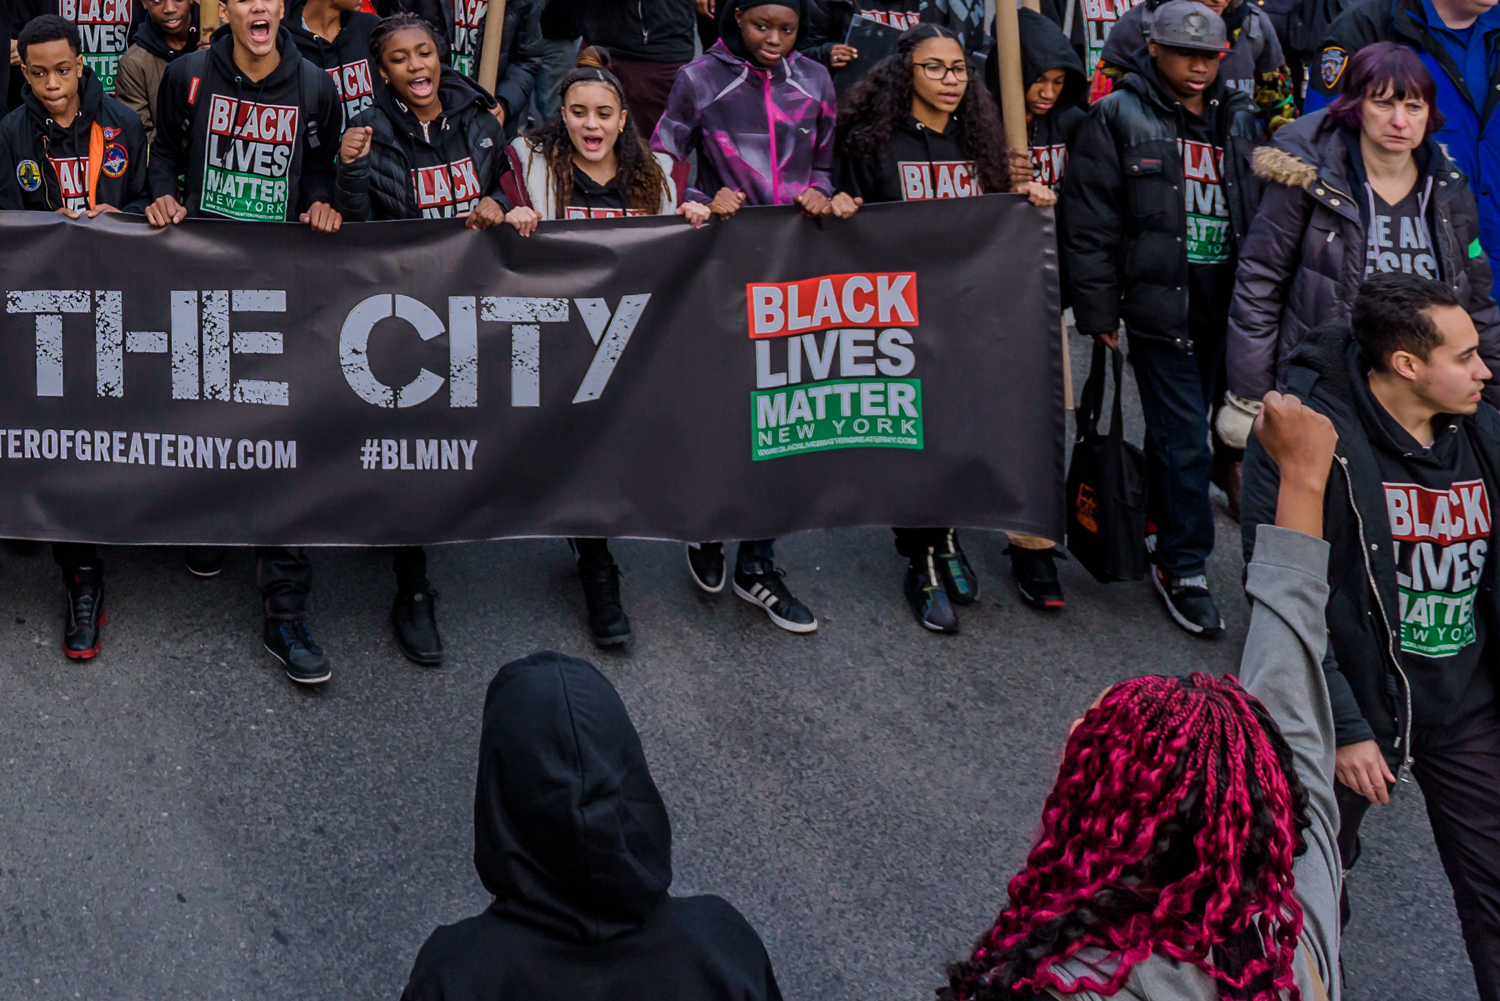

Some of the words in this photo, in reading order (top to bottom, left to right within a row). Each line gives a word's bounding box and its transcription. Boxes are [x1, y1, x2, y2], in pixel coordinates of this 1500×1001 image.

[80, 25, 127, 53] IVES
[83, 54, 124, 75] ATTE
[212, 99, 297, 143] BLACK
[209, 134, 290, 177] LIVES
[206, 169, 287, 203] MATTER
[413, 157, 481, 205] LACK
[1185, 180, 1229, 217] IVE
[206, 191, 236, 209] NEW
[244, 200, 284, 214] YORK
[1186, 216, 1230, 242] ATT
[753, 273, 914, 334] BLACK
[5, 289, 289, 406] THE
[338, 292, 652, 408] CITY
[755, 327, 915, 390] LIVES
[756, 381, 920, 429] MATTER
[758, 423, 816, 446] NEW
[832, 418, 917, 436] YORK
[360, 438, 478, 471] #BLMNY
[1387, 484, 1488, 539] BLACK
[1400, 595, 1474, 628] MATTE
